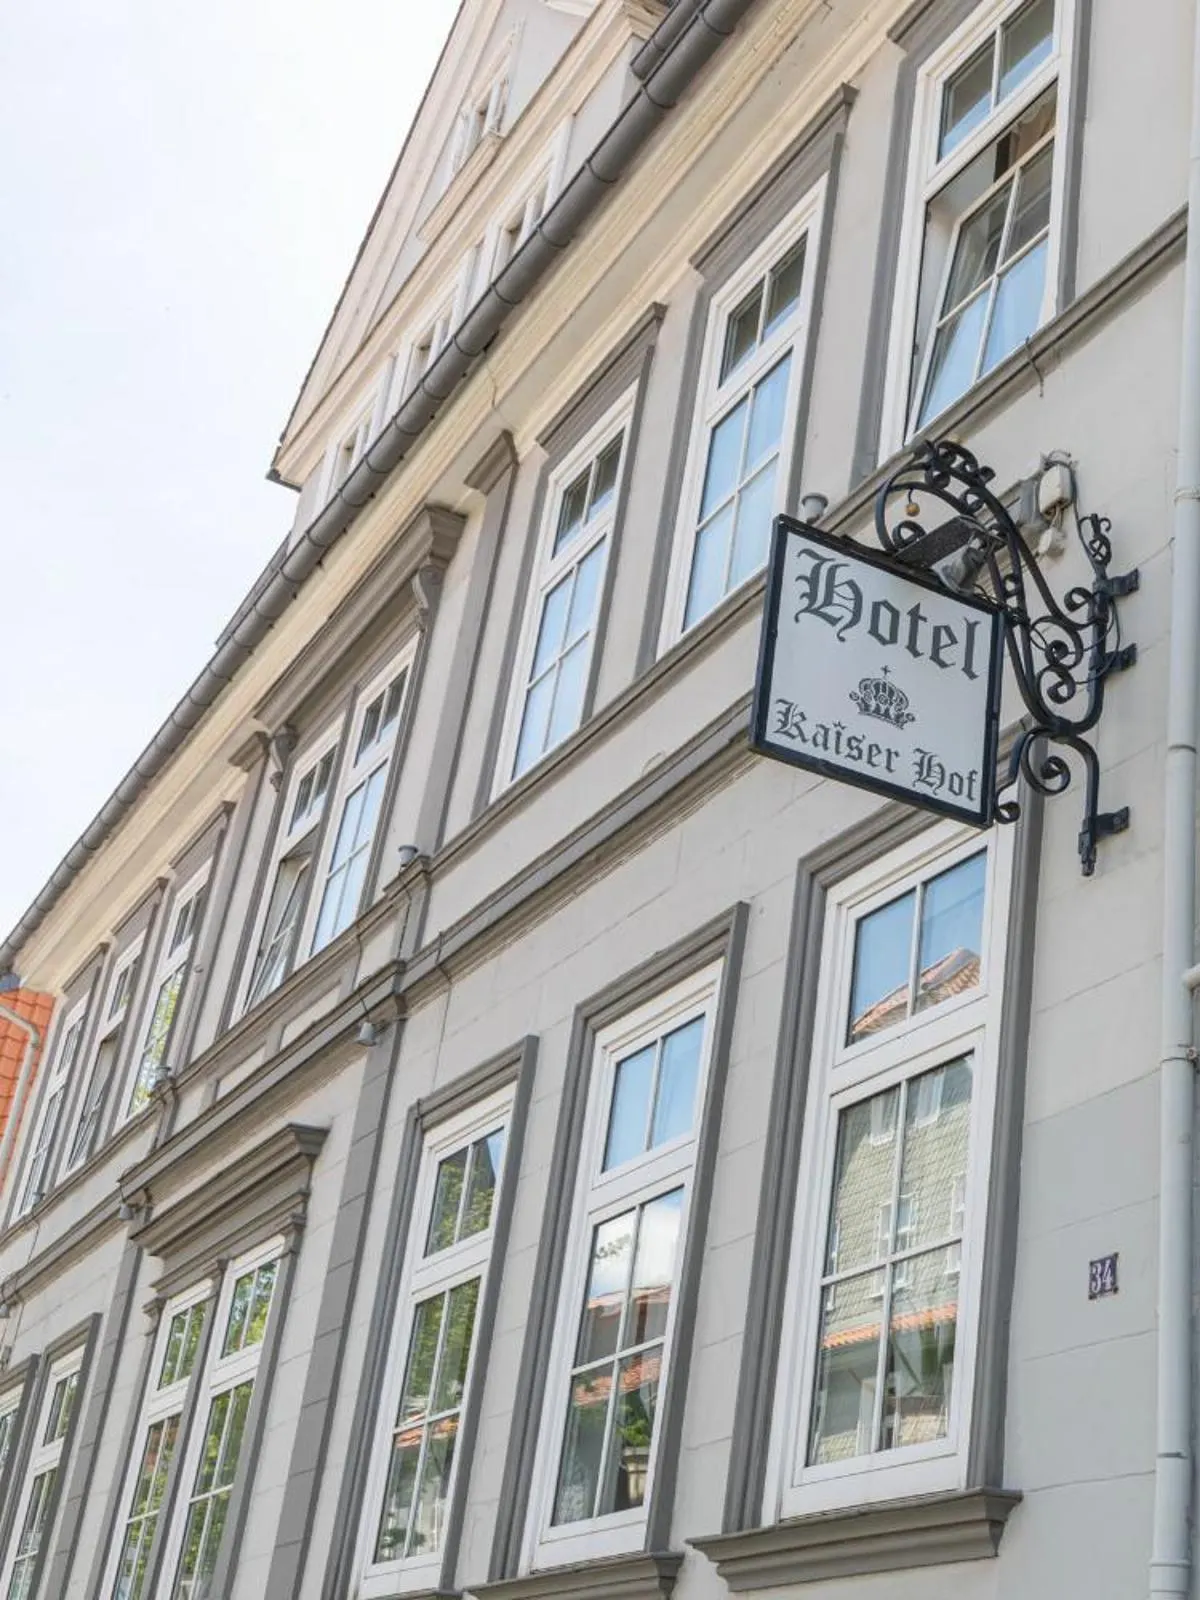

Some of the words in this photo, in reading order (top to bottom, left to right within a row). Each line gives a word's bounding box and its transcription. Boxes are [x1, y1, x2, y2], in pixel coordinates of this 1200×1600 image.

[794, 548, 981, 680] Hotel
[773, 698, 900, 773] Kaiser
[912, 748, 978, 801] Hof
[1091, 1258, 1114, 1293] 34
